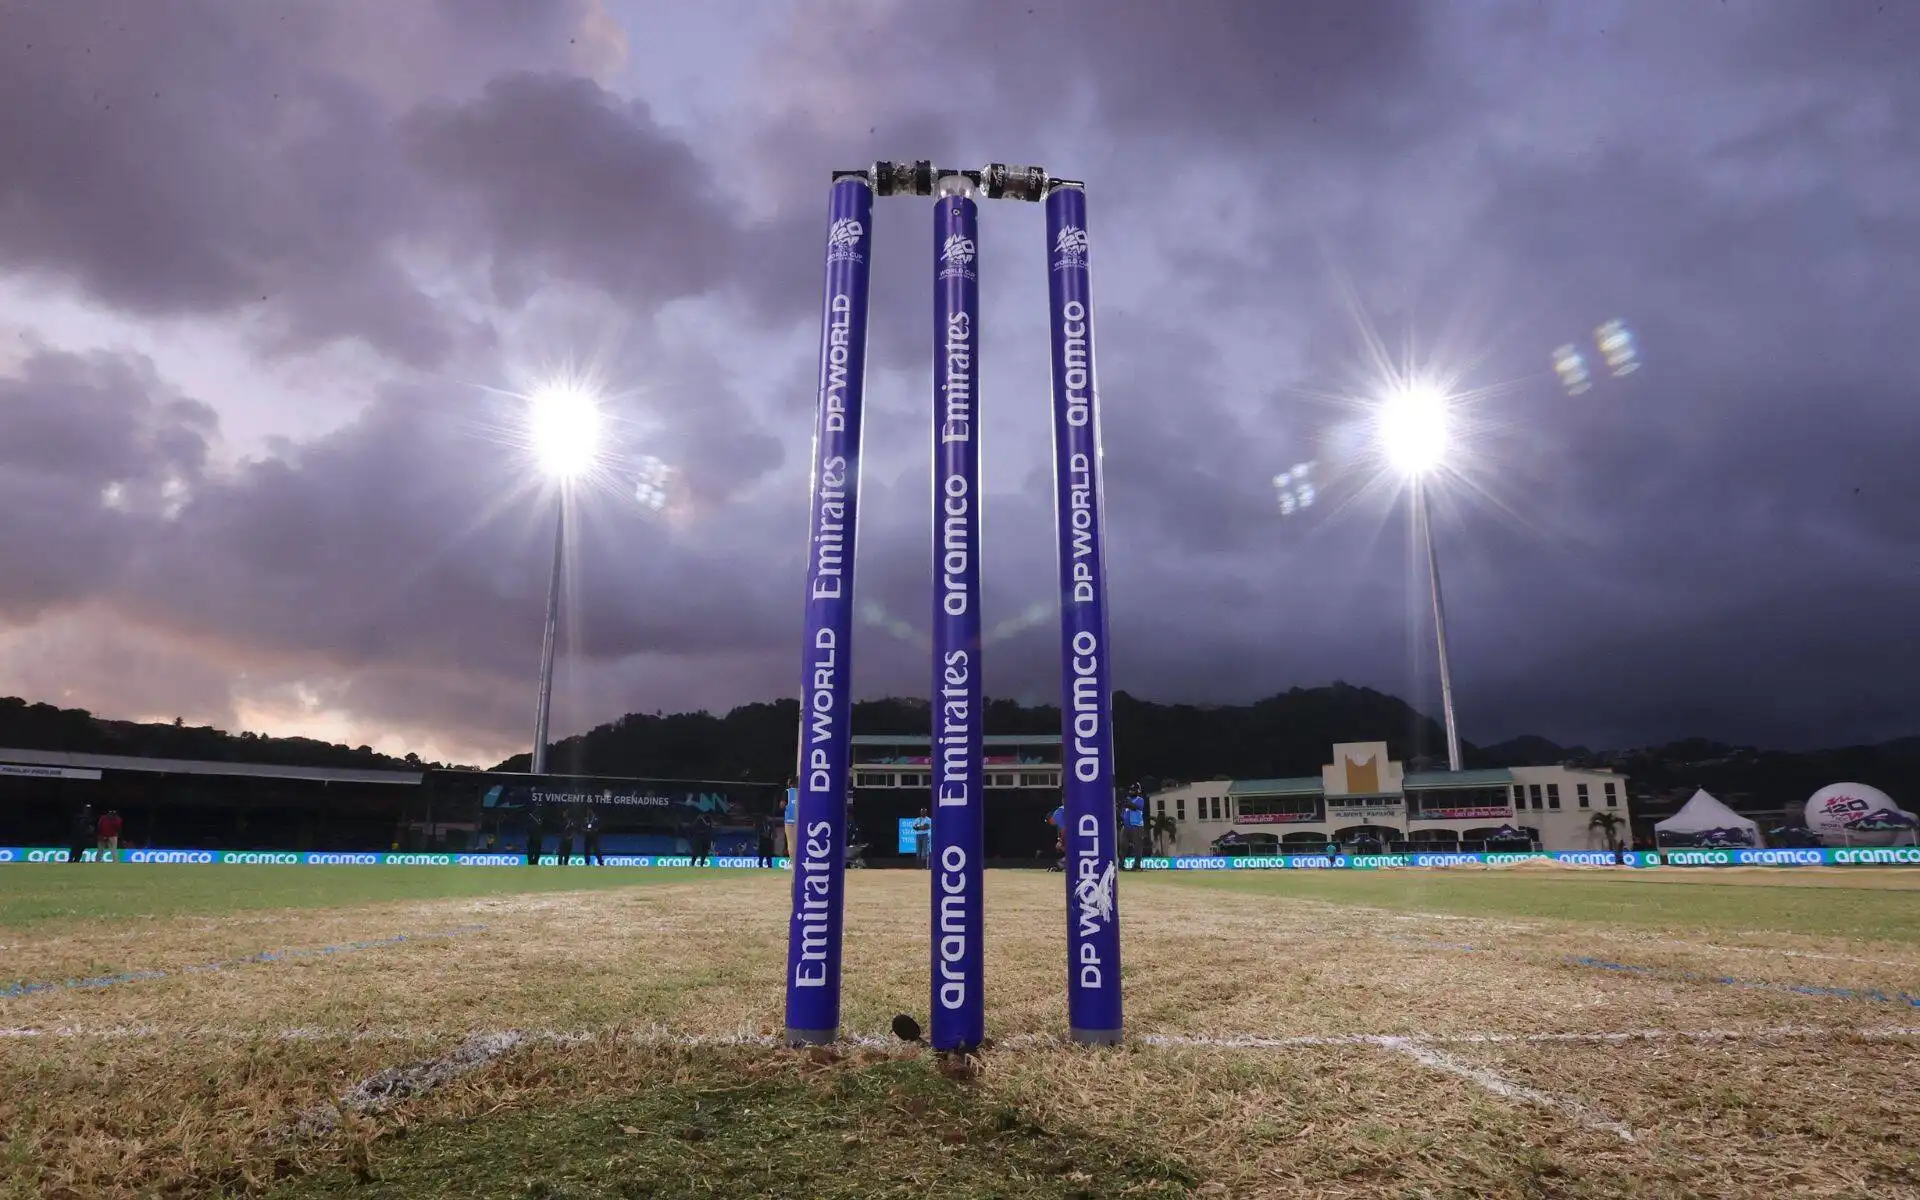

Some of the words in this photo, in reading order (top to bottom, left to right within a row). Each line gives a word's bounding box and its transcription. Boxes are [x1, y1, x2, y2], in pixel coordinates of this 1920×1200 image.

[940, 268, 964, 276] WORLD
[828, 294, 850, 392] WORLD
[941, 311, 970, 446] Emirates
[1065, 300, 1087, 427] aramco
[826, 394, 846, 433] DP
[813, 455, 845, 601] Emirates
[943, 473, 968, 616] aramco
[1071, 453, 1092, 559] WORLD
[1074, 562, 1095, 602] DP
[812, 627, 836, 744] WORLD
[938, 649, 968, 807] Emirates
[1073, 631, 1099, 782] aramco
[532, 793, 543, 802] ST
[545, 793, 585, 803] VINCENT
[587, 795, 593, 803] &
[594, 795, 612, 804] THE
[614, 796, 669, 806] GRENADINES
[810, 748, 831, 792] DP
[131, 851, 212, 863] aramco
[224, 852, 297, 864] aramco
[308, 854, 376, 865] aramco
[386, 854, 449, 865] aramco
[460, 855, 519, 865] aramco
[796, 821, 831, 987] Emirates
[1077, 814, 1101, 937] WORLD
[1176, 858, 1226, 869] aramco
[1234, 857, 1284, 868] aramco
[1292, 857, 1345, 867] aramo
[1560, 853, 1635, 865] aramco
[1740, 850, 1821, 863] aramco
[1835, 849, 1920, 863] aramco
[940, 845, 966, 1009] aramco
[1080, 942, 1101, 988] DP
